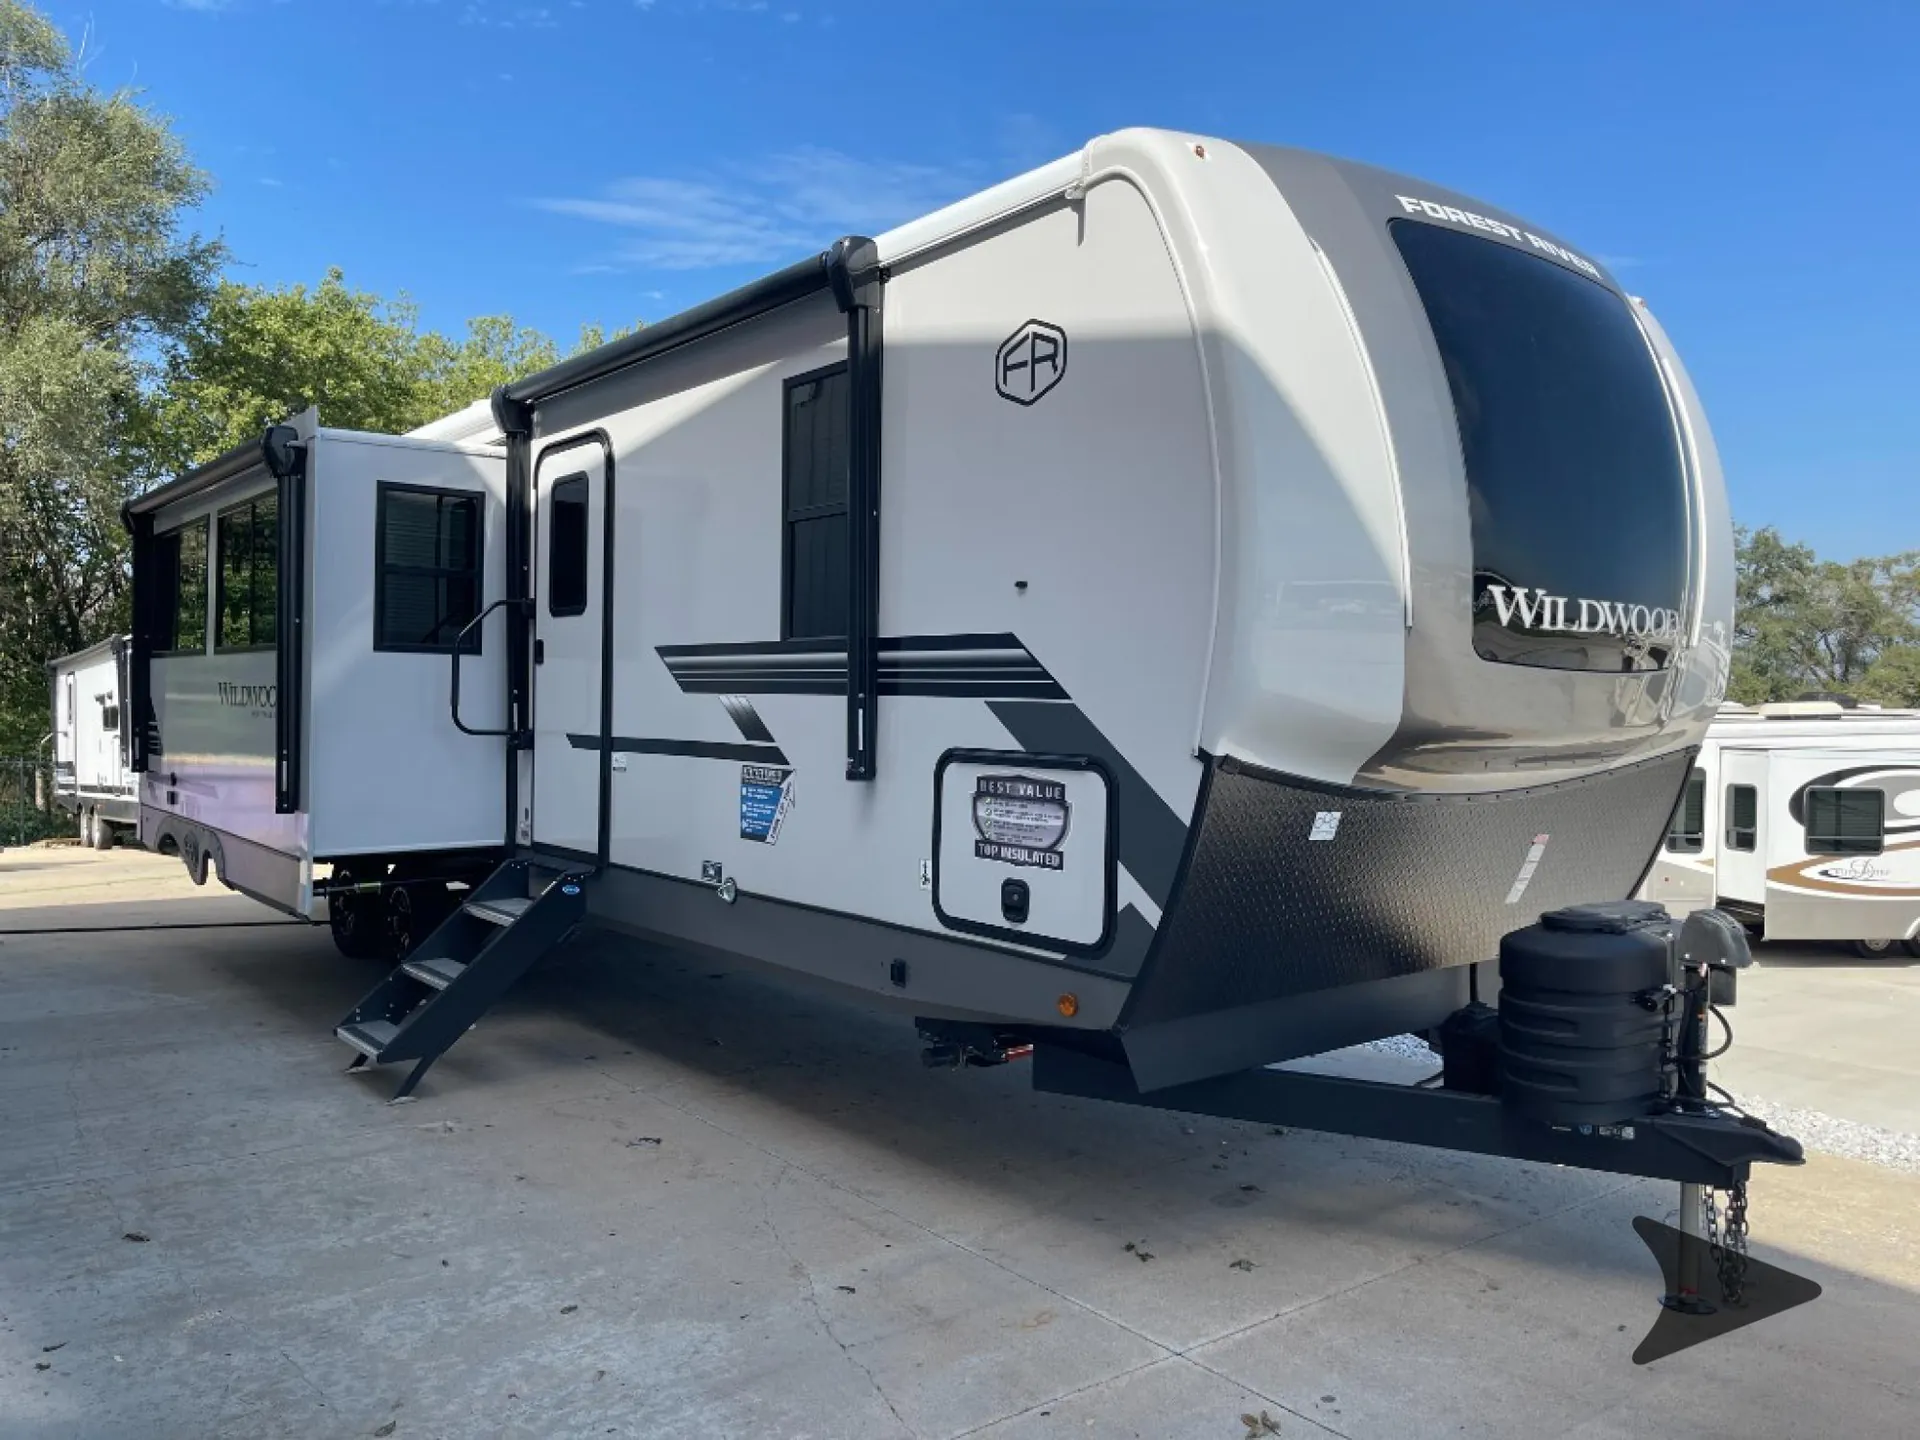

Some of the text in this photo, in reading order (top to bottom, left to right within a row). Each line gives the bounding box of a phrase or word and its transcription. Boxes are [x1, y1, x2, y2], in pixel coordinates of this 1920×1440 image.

[1394, 194, 1522, 241] FOREST
[1487, 584, 1680, 639] WILDWOOD
[218, 682, 276, 707] WILDWOO
[980, 780, 1063, 799] BEST VALUE
[979, 843, 1060, 867] TOP INSULATED
